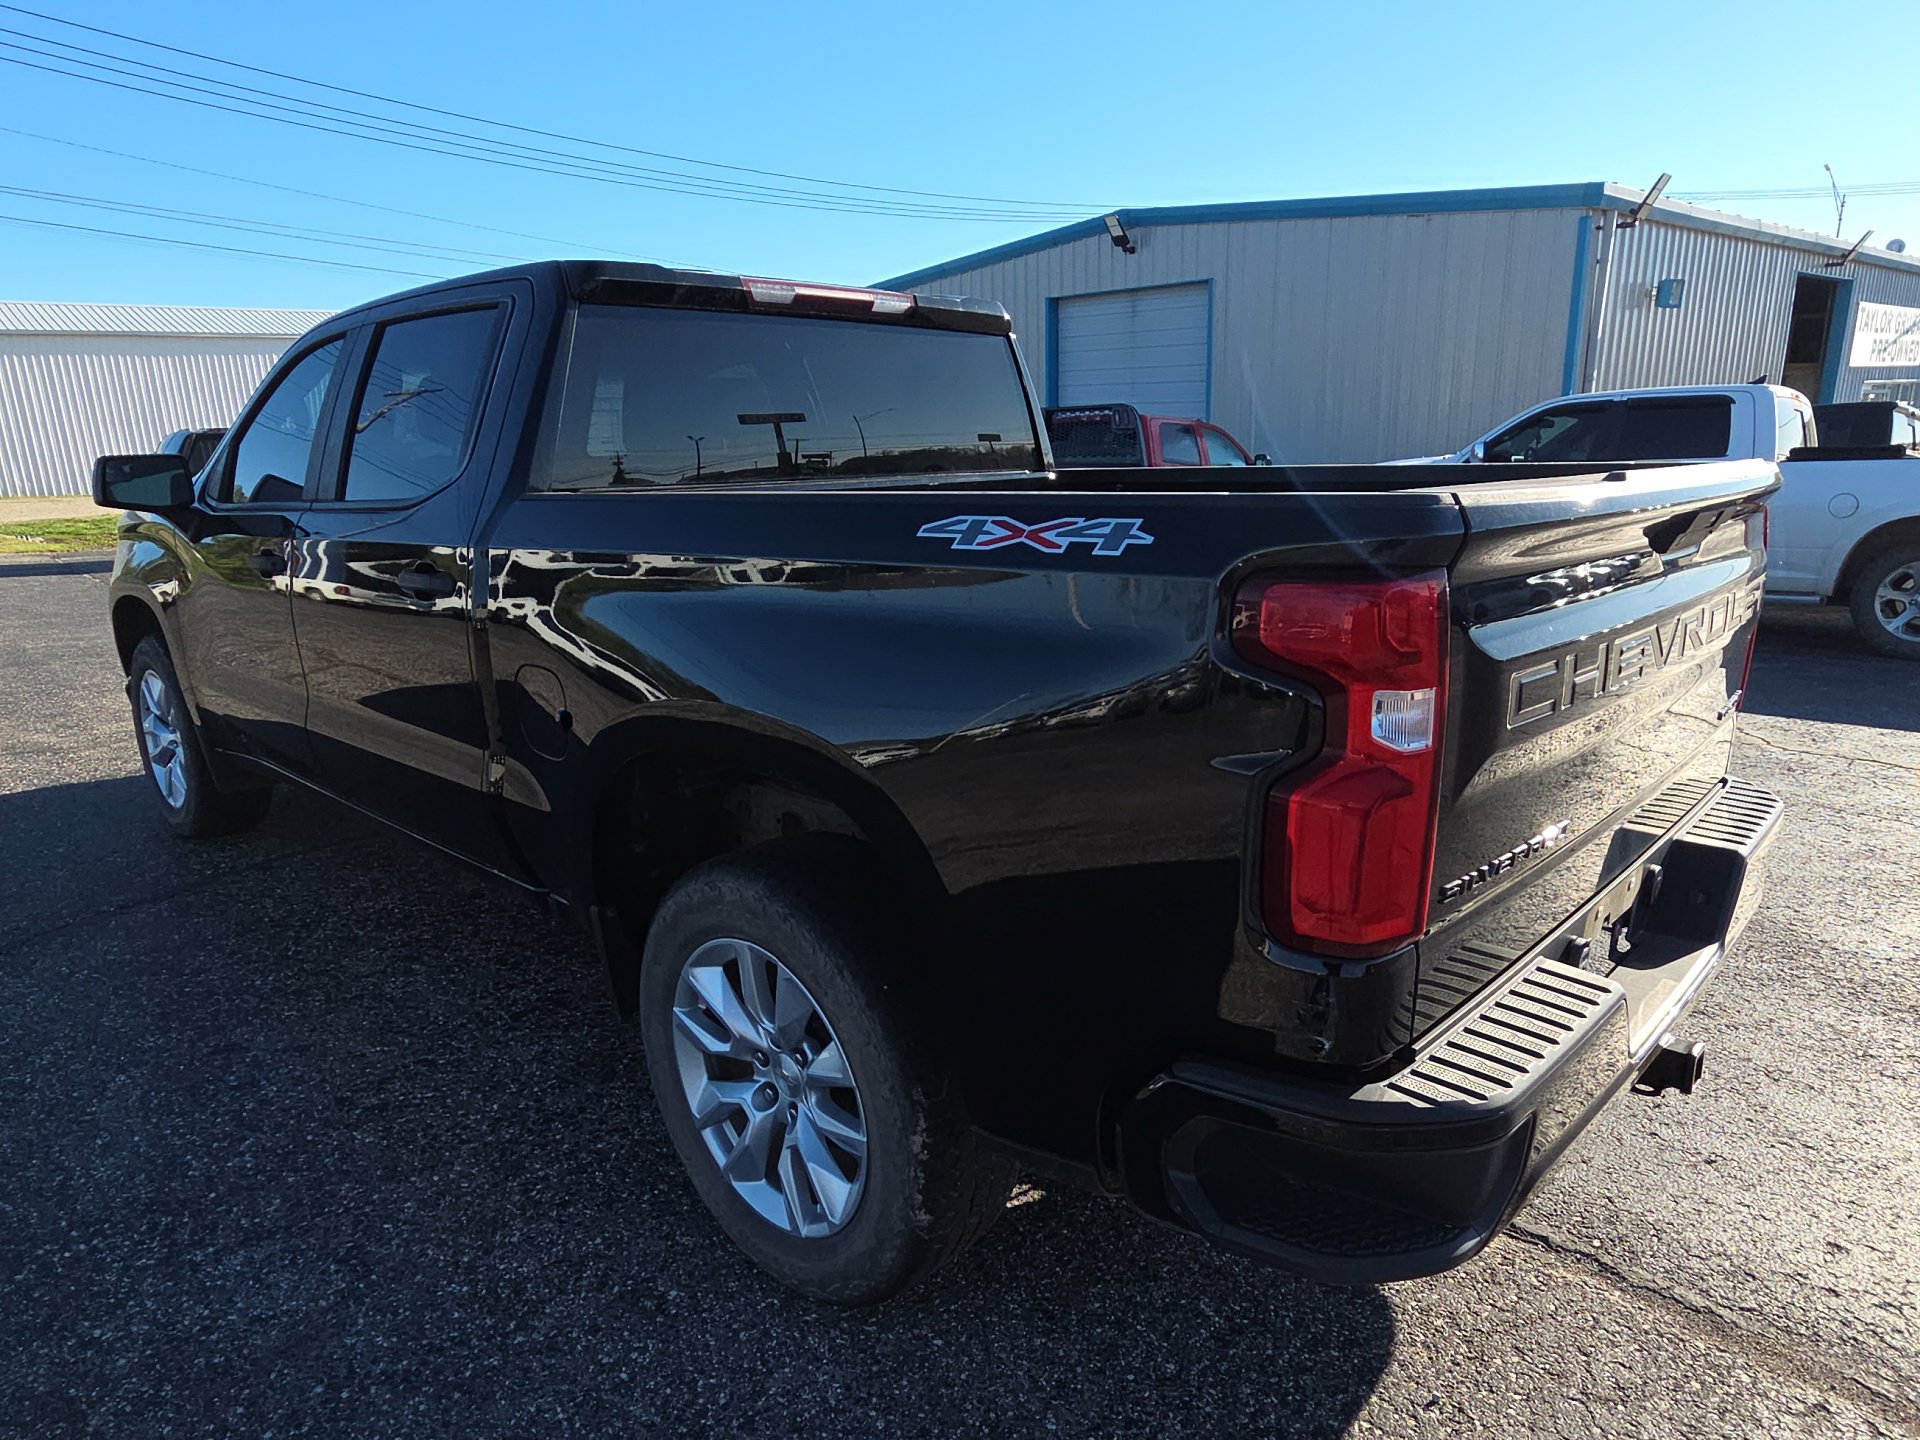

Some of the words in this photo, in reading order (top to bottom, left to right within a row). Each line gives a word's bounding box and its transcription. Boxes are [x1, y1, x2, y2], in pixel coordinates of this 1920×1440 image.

[1858, 306, 1894, 334] TAYLOR
[1869, 337, 1920, 363] PRE-OWNED
[1506, 573, 1766, 730] CHEVROLE
